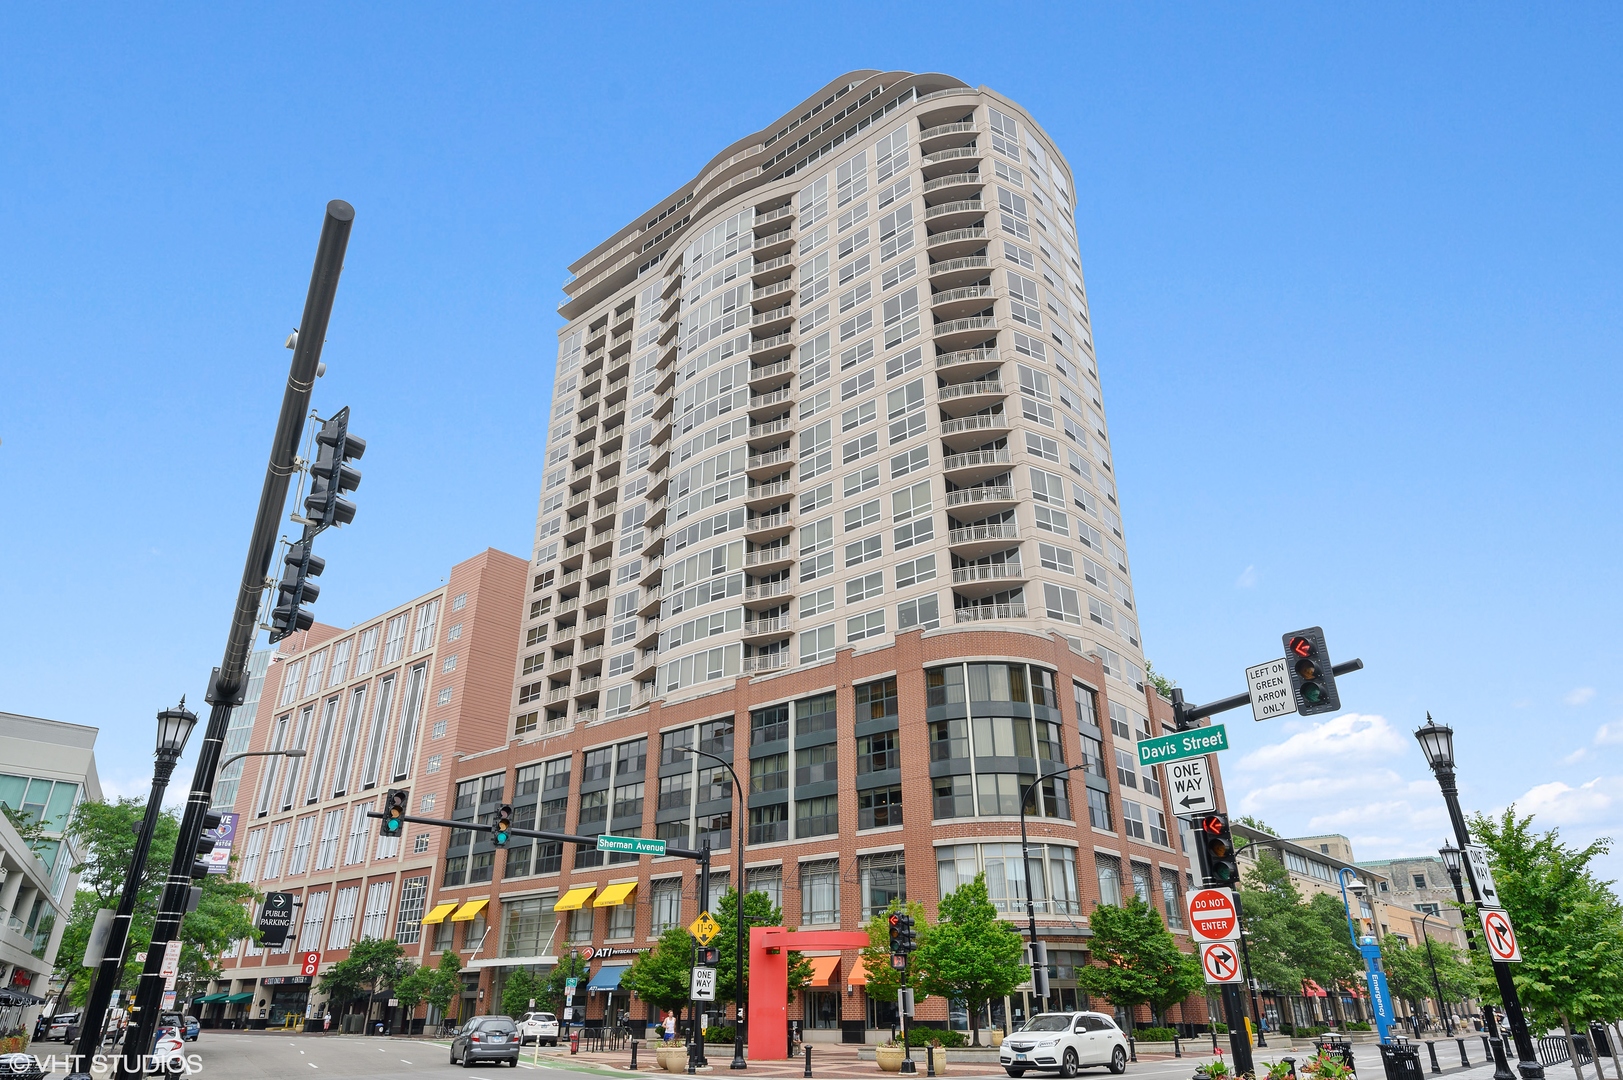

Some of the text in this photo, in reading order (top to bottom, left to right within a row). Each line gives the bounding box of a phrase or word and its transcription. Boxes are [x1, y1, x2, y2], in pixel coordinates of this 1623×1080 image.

[1250, 663, 1284, 680] LEFT ON
[1256, 676, 1283, 691] GREEN
[1258, 688, 1287, 703] ARROW
[1262, 701, 1286, 715] ONLY
[1141, 731, 1224, 760] Davis Street
[1173, 762, 1201, 778] ONE
[1174, 777, 1202, 793] WAY
[599, 838, 664, 852] Sherman Avenue
[1470, 850, 1485, 864] ONE
[1473, 866, 1489, 881] WAY
[1195, 898, 1225, 909] DO NOT
[265, 910, 289, 918] PUBLIC
[260, 918, 290, 927] PARKING
[1201, 920, 1228, 931] ENTER
[594, 948, 613, 958] ATI
[697, 971, 712, 979] ONE
[696, 980, 712, 988] WAY
[1371, 974, 1386, 1018] Emergency
